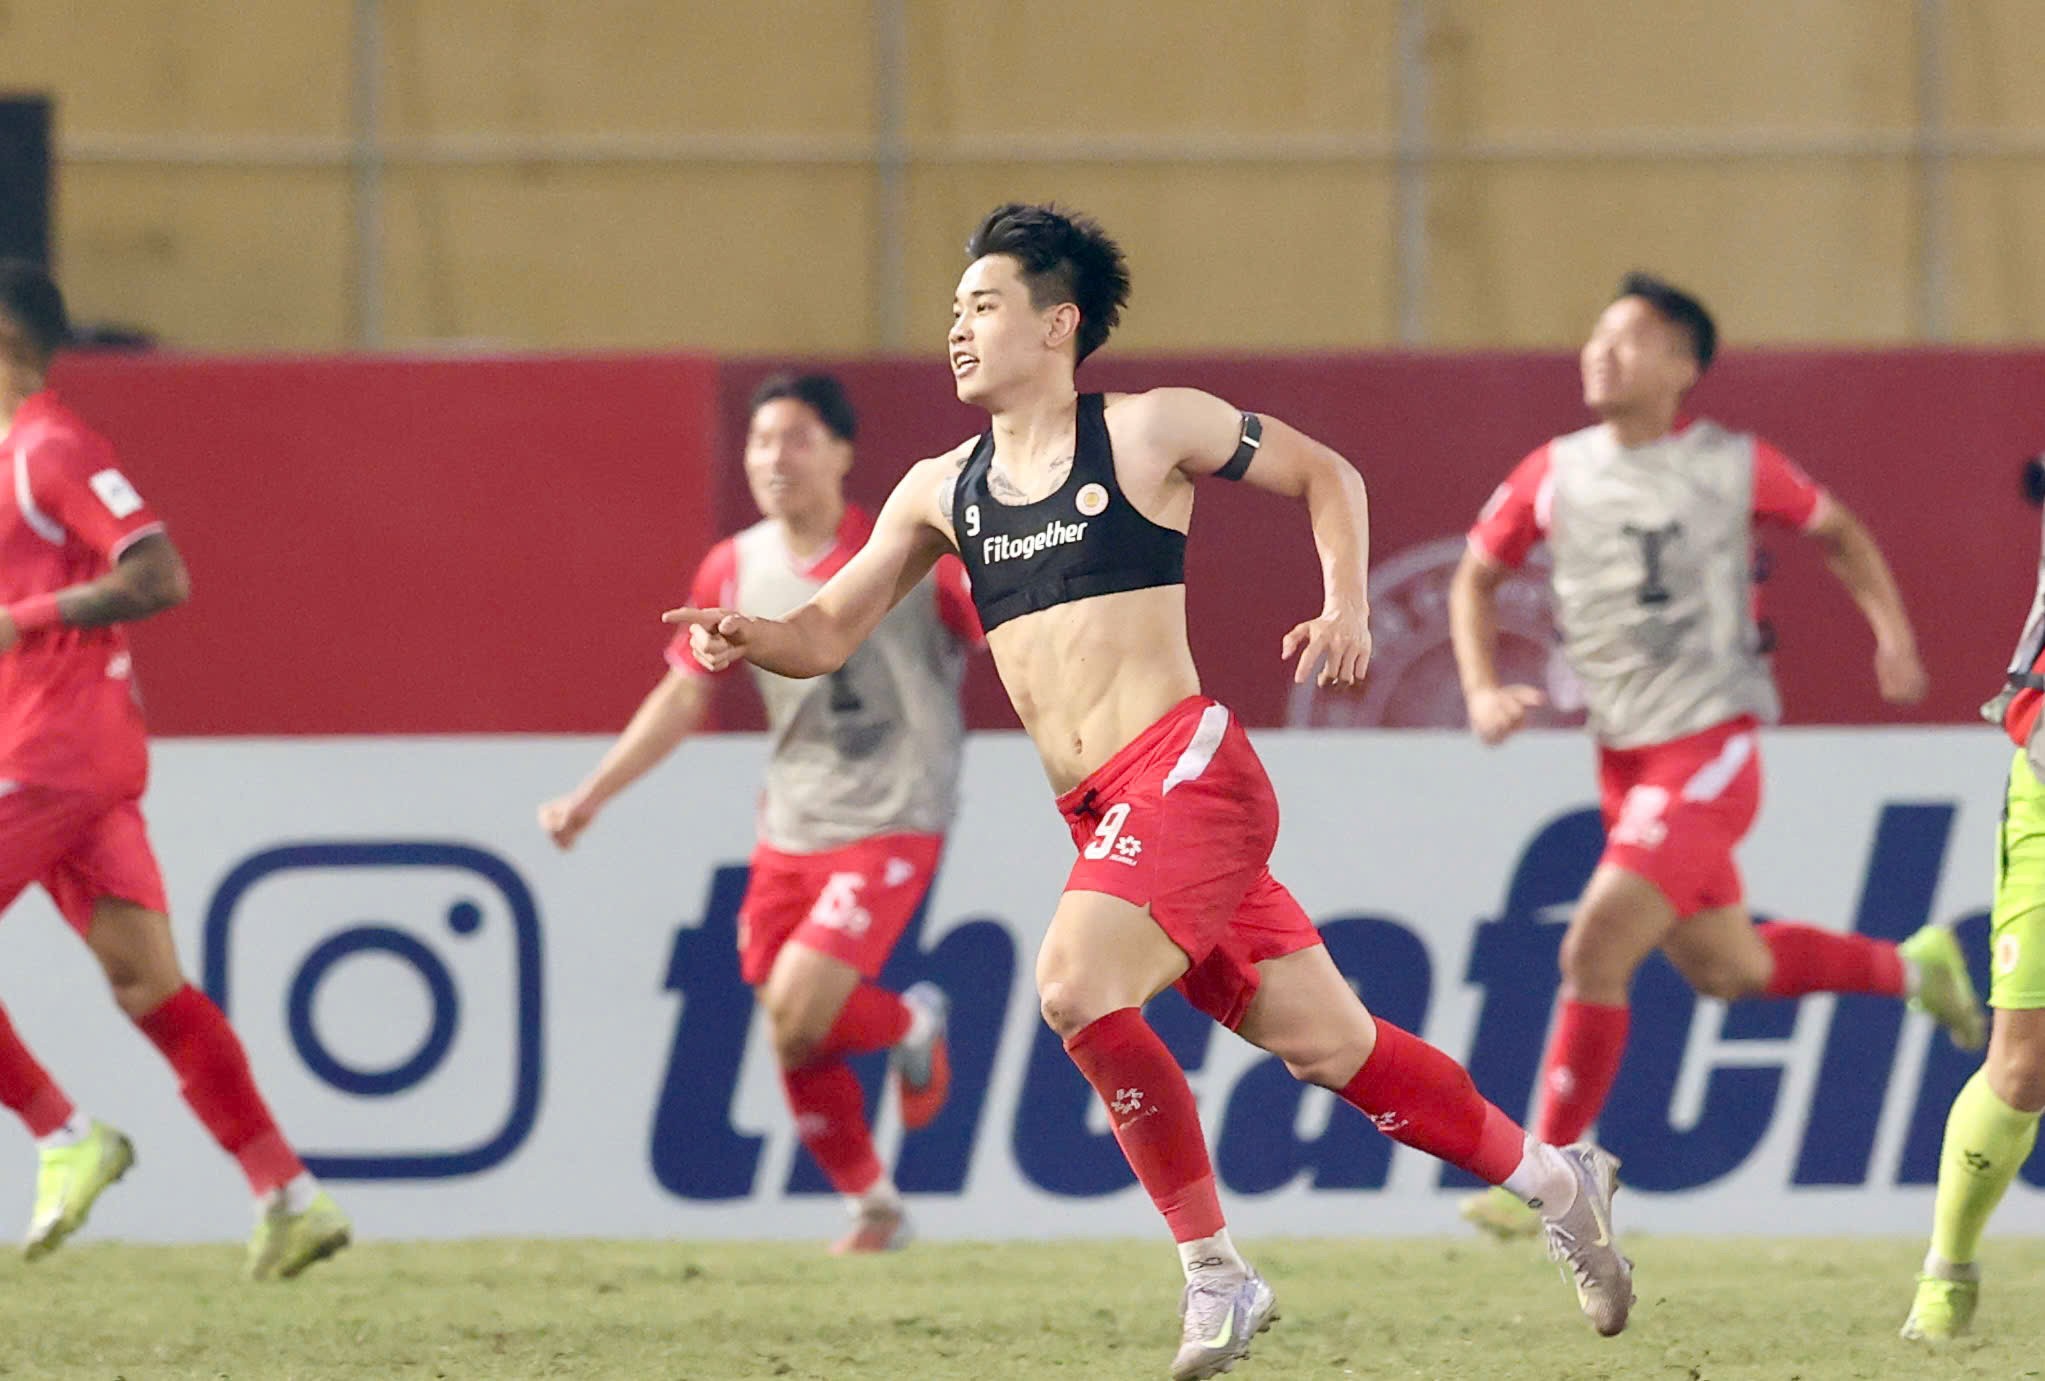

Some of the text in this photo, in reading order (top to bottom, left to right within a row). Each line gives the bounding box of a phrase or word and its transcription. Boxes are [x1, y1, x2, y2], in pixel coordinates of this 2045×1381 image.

[965, 504, 981, 537] 9
[983, 519, 1088, 565] Fitogether
[1083, 802, 1132, 860] 9
[649, 803, 2045, 1200] theafch
